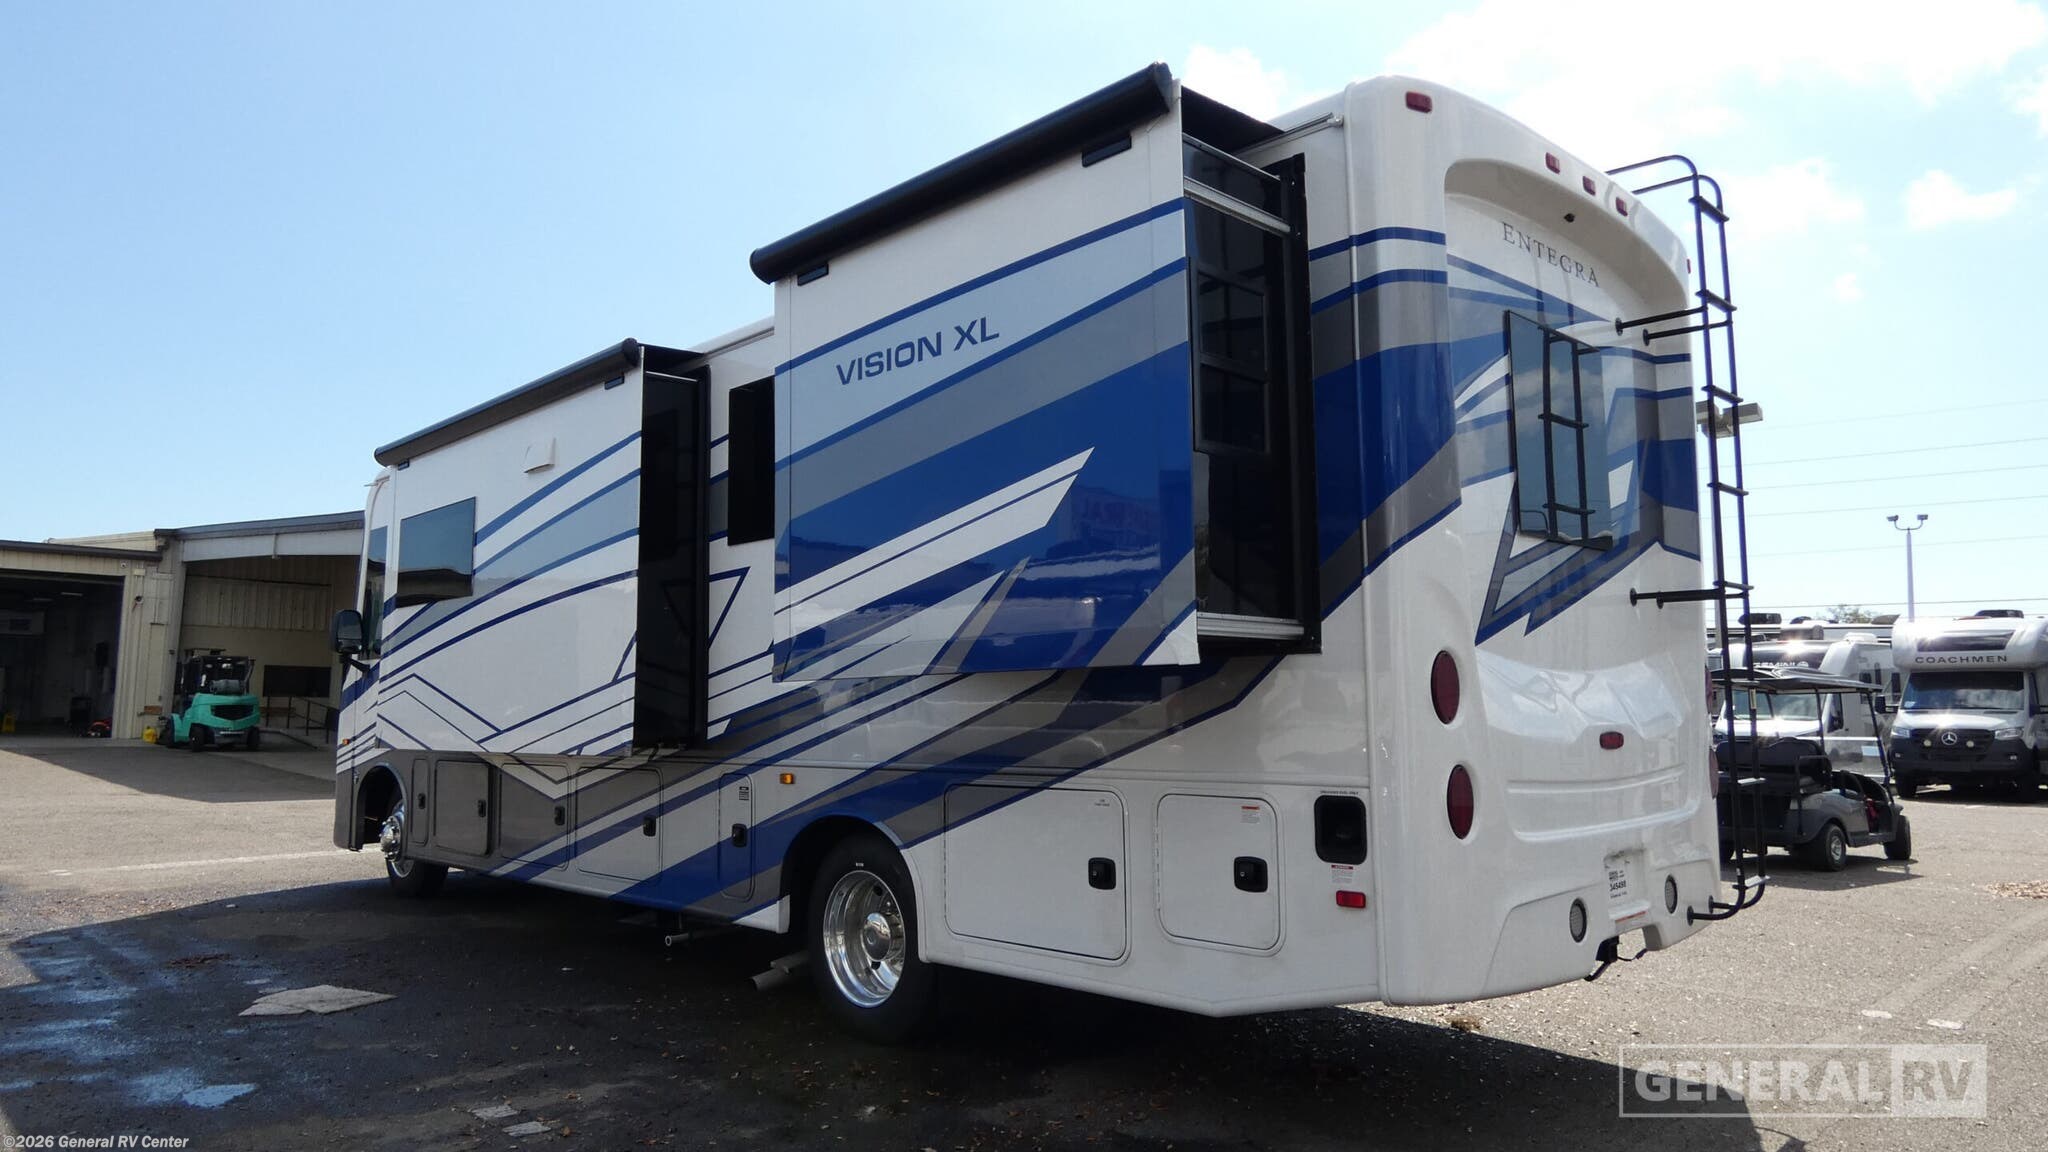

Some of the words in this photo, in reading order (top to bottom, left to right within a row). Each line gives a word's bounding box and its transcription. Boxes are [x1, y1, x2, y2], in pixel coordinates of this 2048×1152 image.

[1503, 221, 1600, 288] ENTEGRA
[836, 331, 942, 385] VISION
[953, 316, 1000, 351] XL
[1915, 655, 2007, 664] COACHMEN
